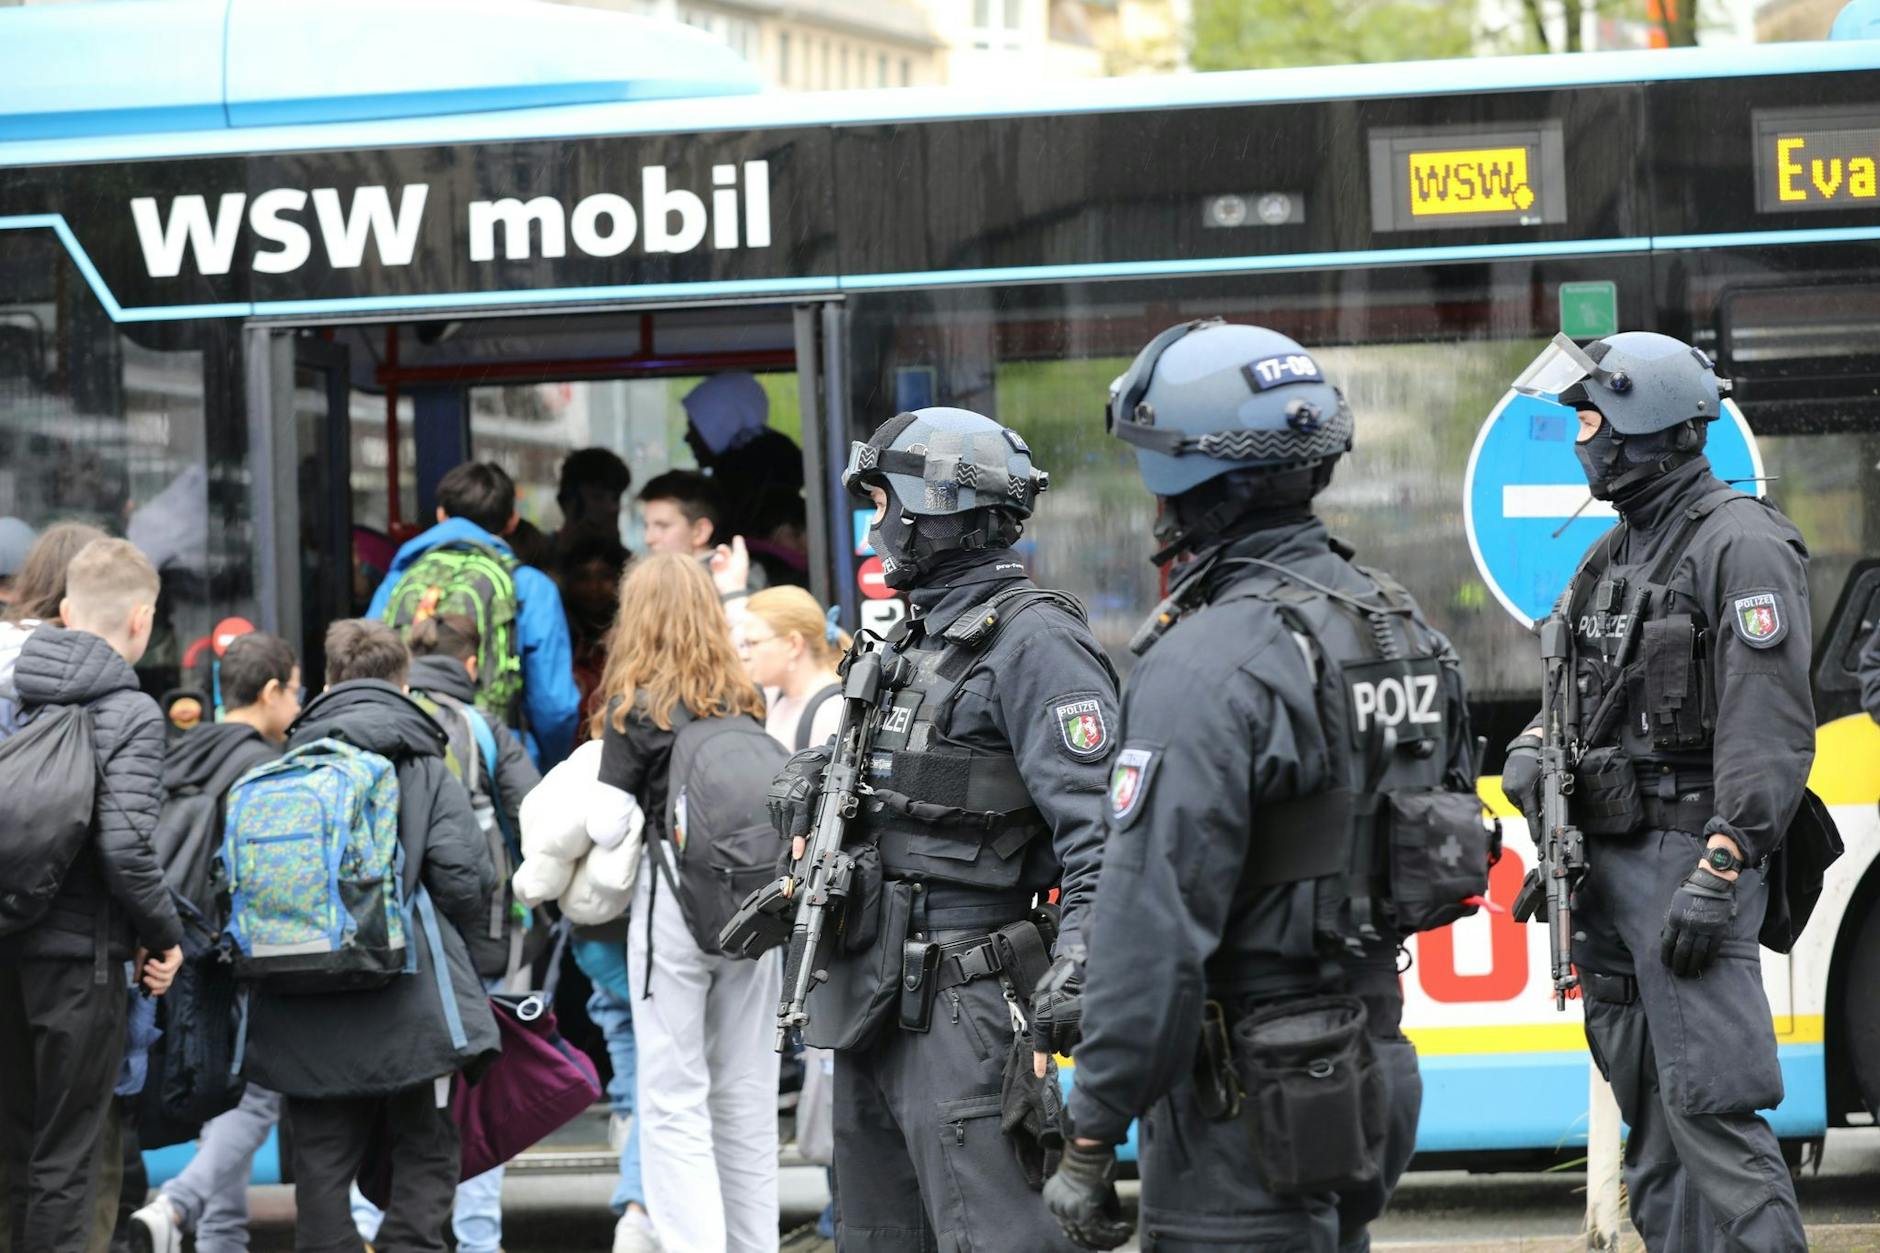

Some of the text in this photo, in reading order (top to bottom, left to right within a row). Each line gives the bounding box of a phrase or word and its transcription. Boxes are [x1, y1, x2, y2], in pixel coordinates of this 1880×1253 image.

[1778, 137, 1876, 201] Eva
[131, 160, 771, 278] WSW mobil
